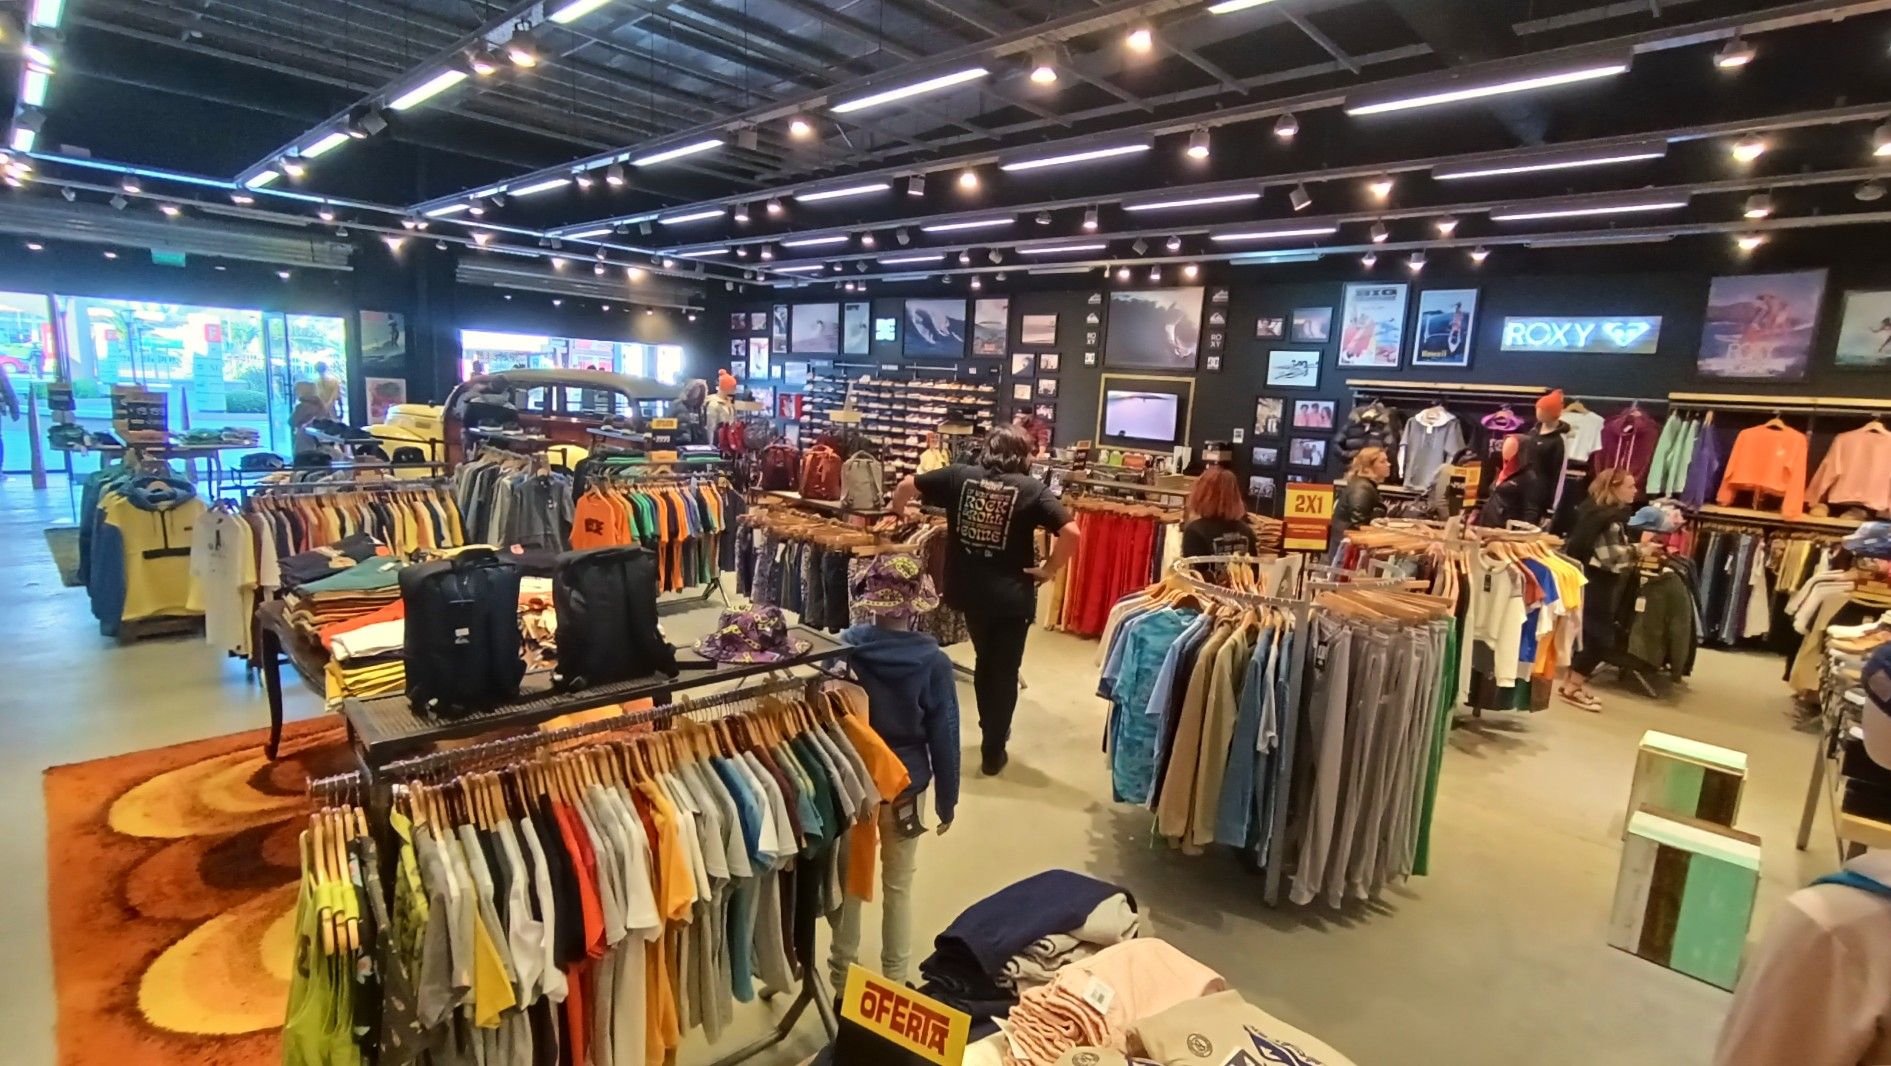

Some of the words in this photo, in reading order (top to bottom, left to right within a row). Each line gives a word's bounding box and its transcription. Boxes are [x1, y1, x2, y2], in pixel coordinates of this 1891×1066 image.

[1210, 333, 1222, 341] RO
[1504, 321, 1596, 347] ROXY
[964, 495, 1008, 513] ROCK
[1294, 494, 1324, 514] 2X1
[968, 509, 1003, 525] ROLL
[859, 980, 951, 1056] OFERTA
